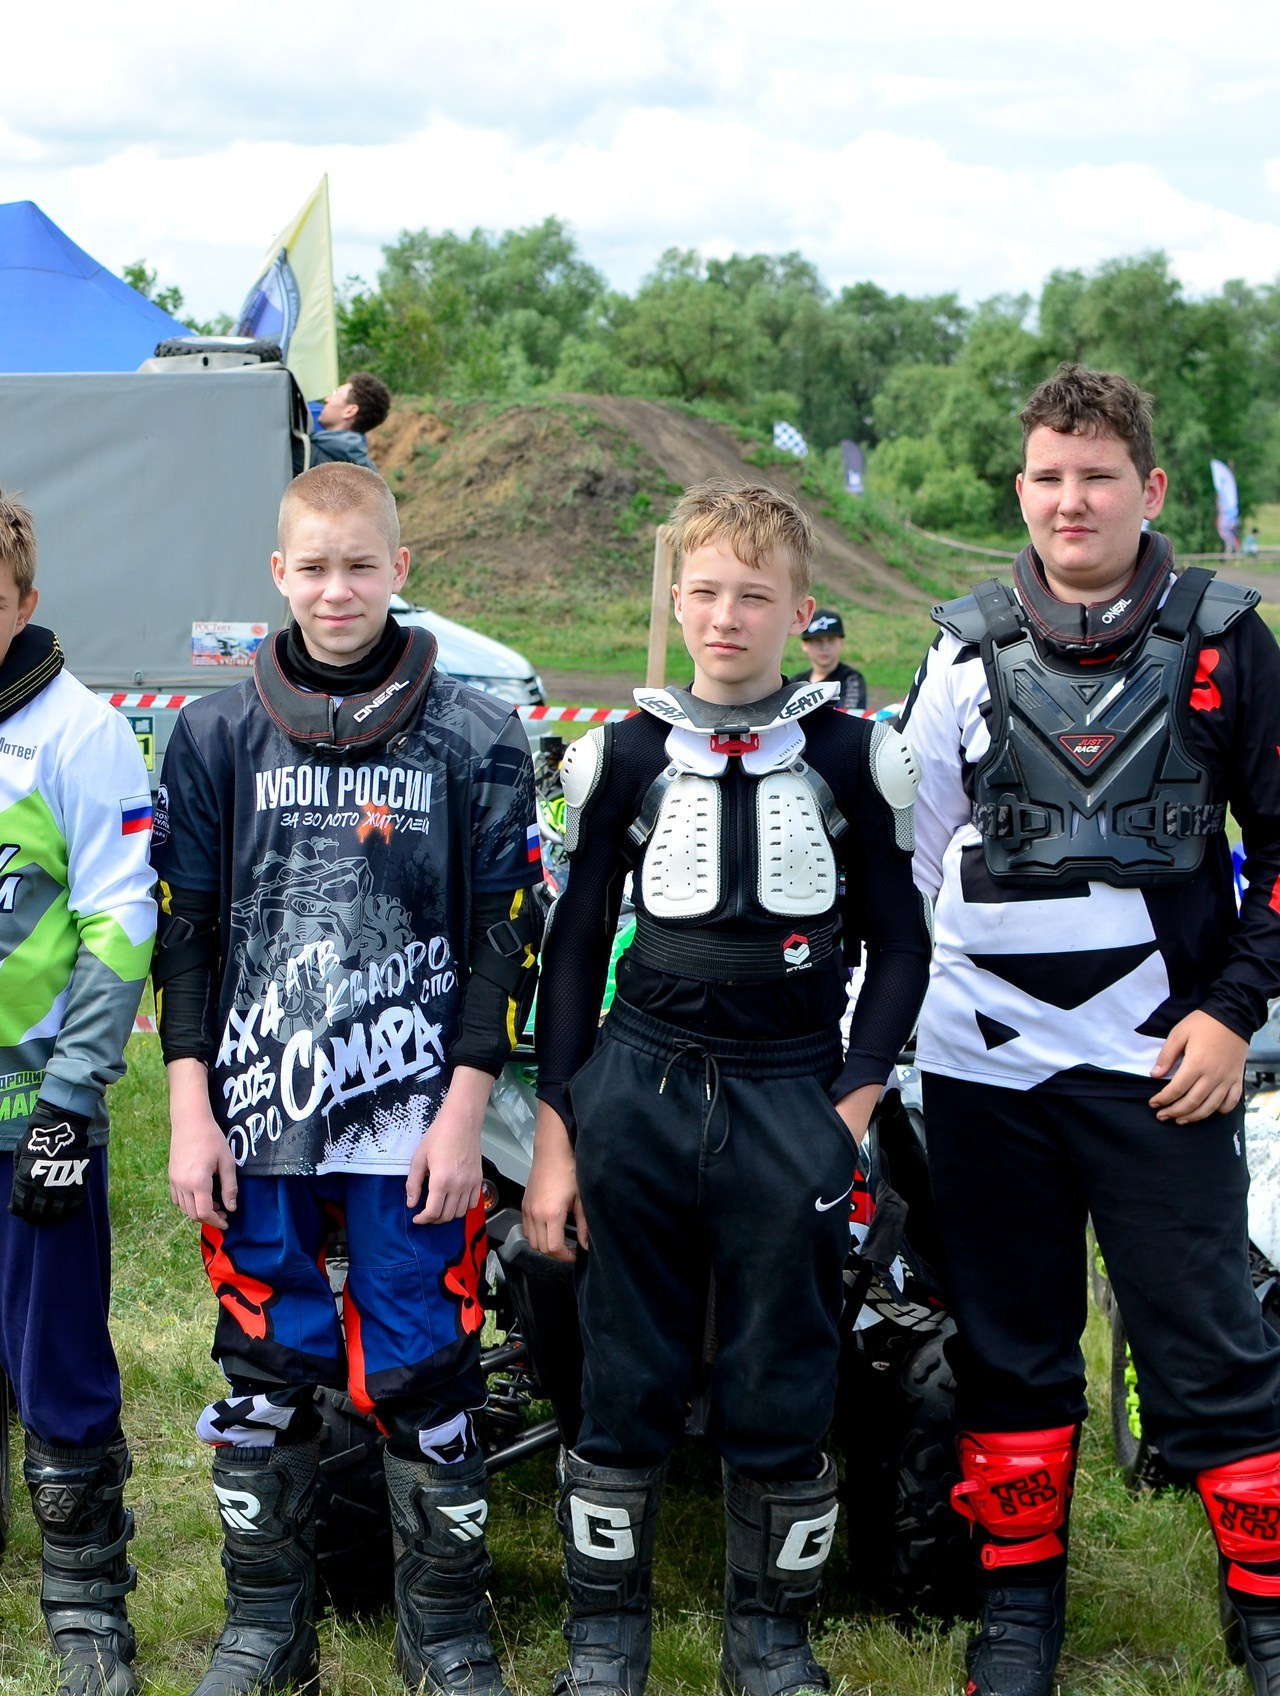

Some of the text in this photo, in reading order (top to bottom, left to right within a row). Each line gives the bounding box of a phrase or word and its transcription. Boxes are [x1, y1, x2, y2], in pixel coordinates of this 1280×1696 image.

[1074, 745, 1101, 753] RACE
[255, 765, 433, 814] КУБОК РОССИИ
[31, 1158, 90, 1187] FOX
[570, 1495, 635, 1561] G
